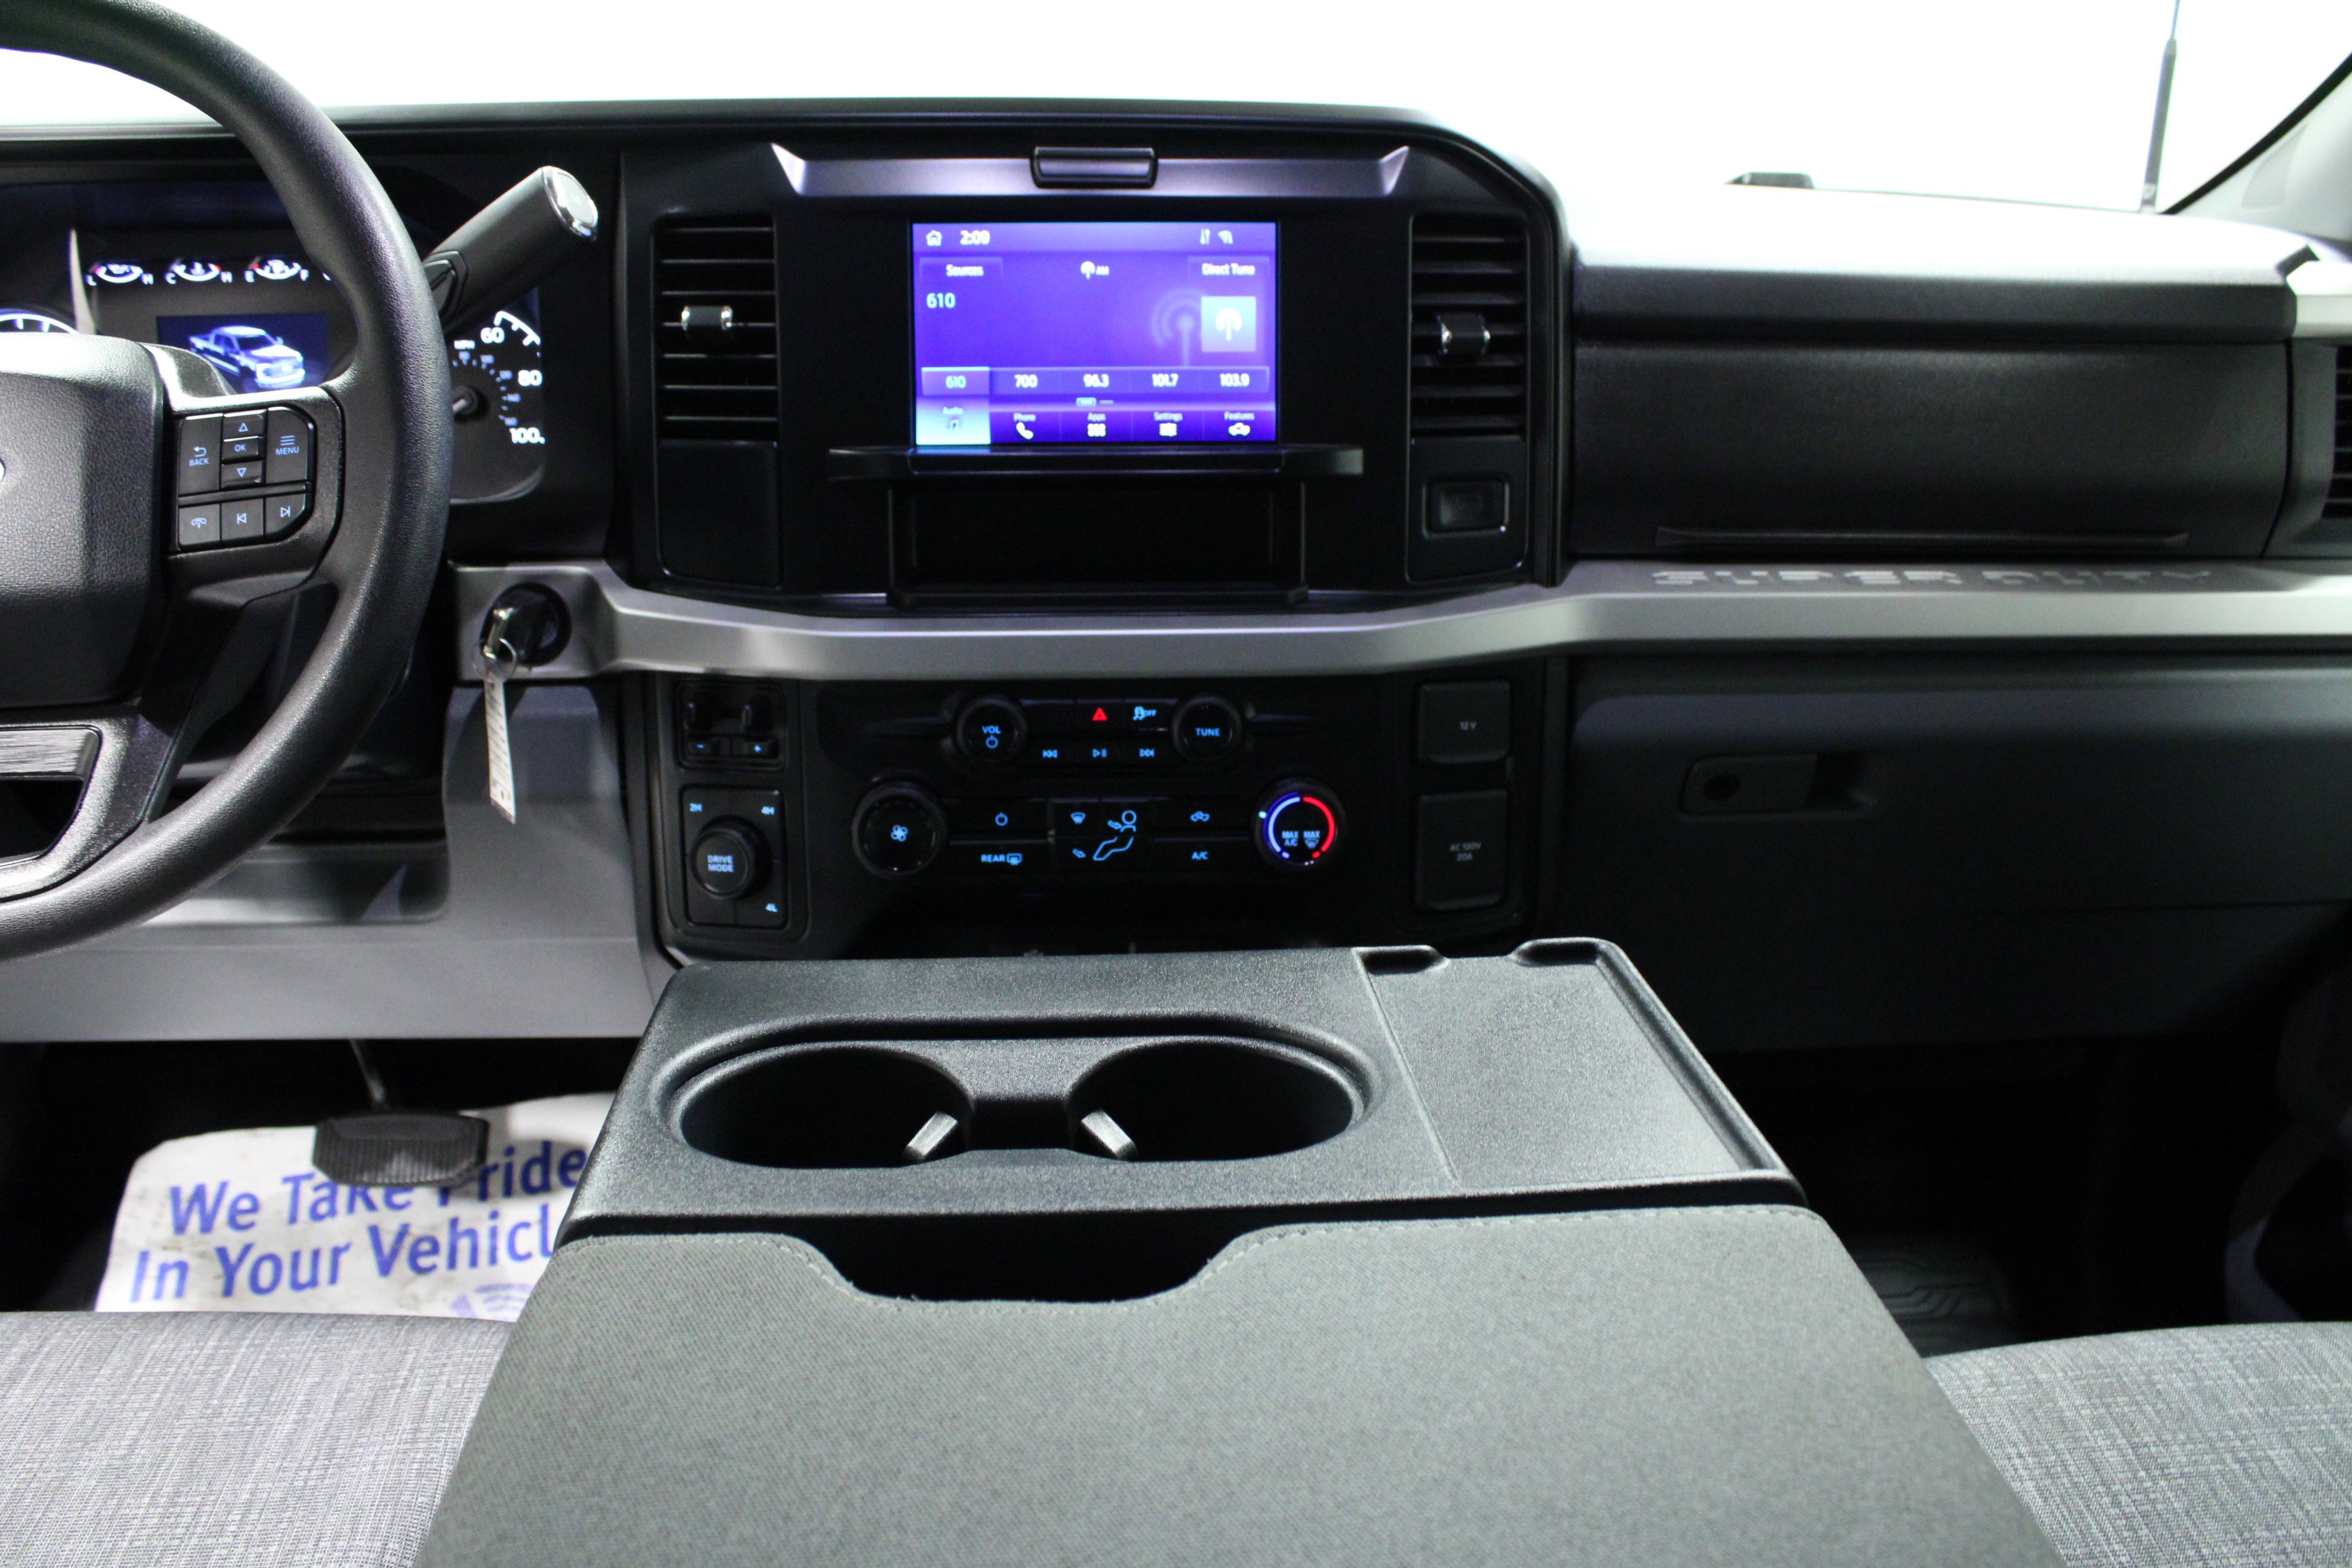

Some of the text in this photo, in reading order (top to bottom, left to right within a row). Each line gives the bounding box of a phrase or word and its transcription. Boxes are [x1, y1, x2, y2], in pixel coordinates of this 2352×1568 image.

[960, 230, 991, 245] 2:09
[946, 264, 984, 277] Sources
[1096, 265, 1110, 276] AM
[1202, 263, 1255, 276] Direct Tune
[926, 292, 956, 309] 610
[481, 326, 505, 344] 60
[518, 370, 543, 387] 80
[946, 375, 966, 390] 610
[1014, 374, 1038, 388] 700
[1083, 374, 1109, 388] 96.3
[1152, 373, 1178, 388] 101.7
[1220, 373, 1250, 387] 103.9
[1154, 411, 1183, 423] Settings
[1224, 411, 1255, 421] Features
[234, 444, 247, 453] OK
[275, 446, 300, 456] MENU
[189, 457, 210, 467] BACK
[982, 725, 1001, 734] VOL
[1195, 727, 1220, 737] TUNE
[1281, 831, 1299, 839] MAX
[707, 855, 733, 864] DRIVE
[981, 854, 1005, 863] REAR
[1191, 851, 1209, 860] A/C
[708, 864, 734, 873] MODE
[169, 1181, 259, 1236] We
[438, 1139, 588, 1207] ride
[129, 1203, 554, 1304] In Your Vehicl
